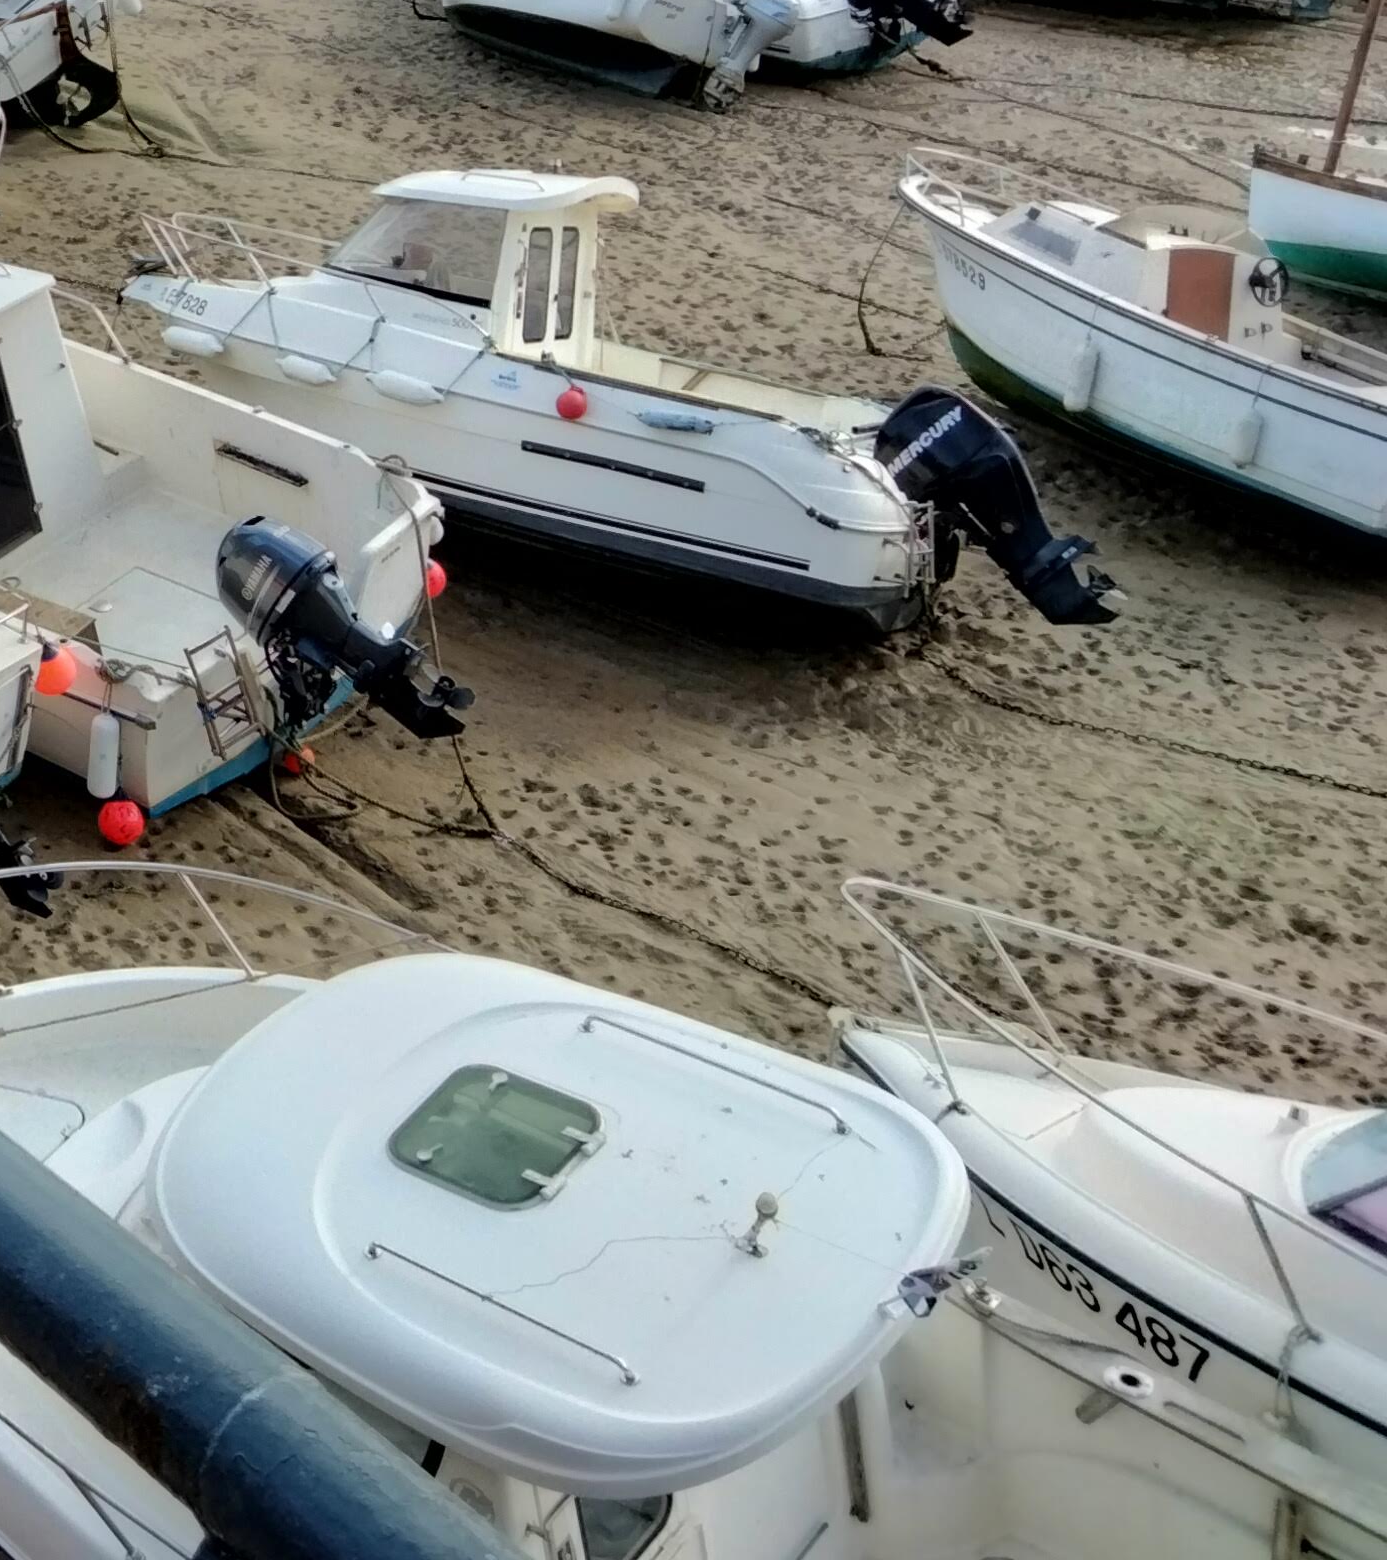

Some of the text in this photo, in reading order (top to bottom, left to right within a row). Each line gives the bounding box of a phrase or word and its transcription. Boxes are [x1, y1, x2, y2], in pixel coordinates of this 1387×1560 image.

[887, 405, 962, 479] MERCURY
[244, 554, 273, 592] YAMAHA
[1115, 1302, 1210, 1383] 487
